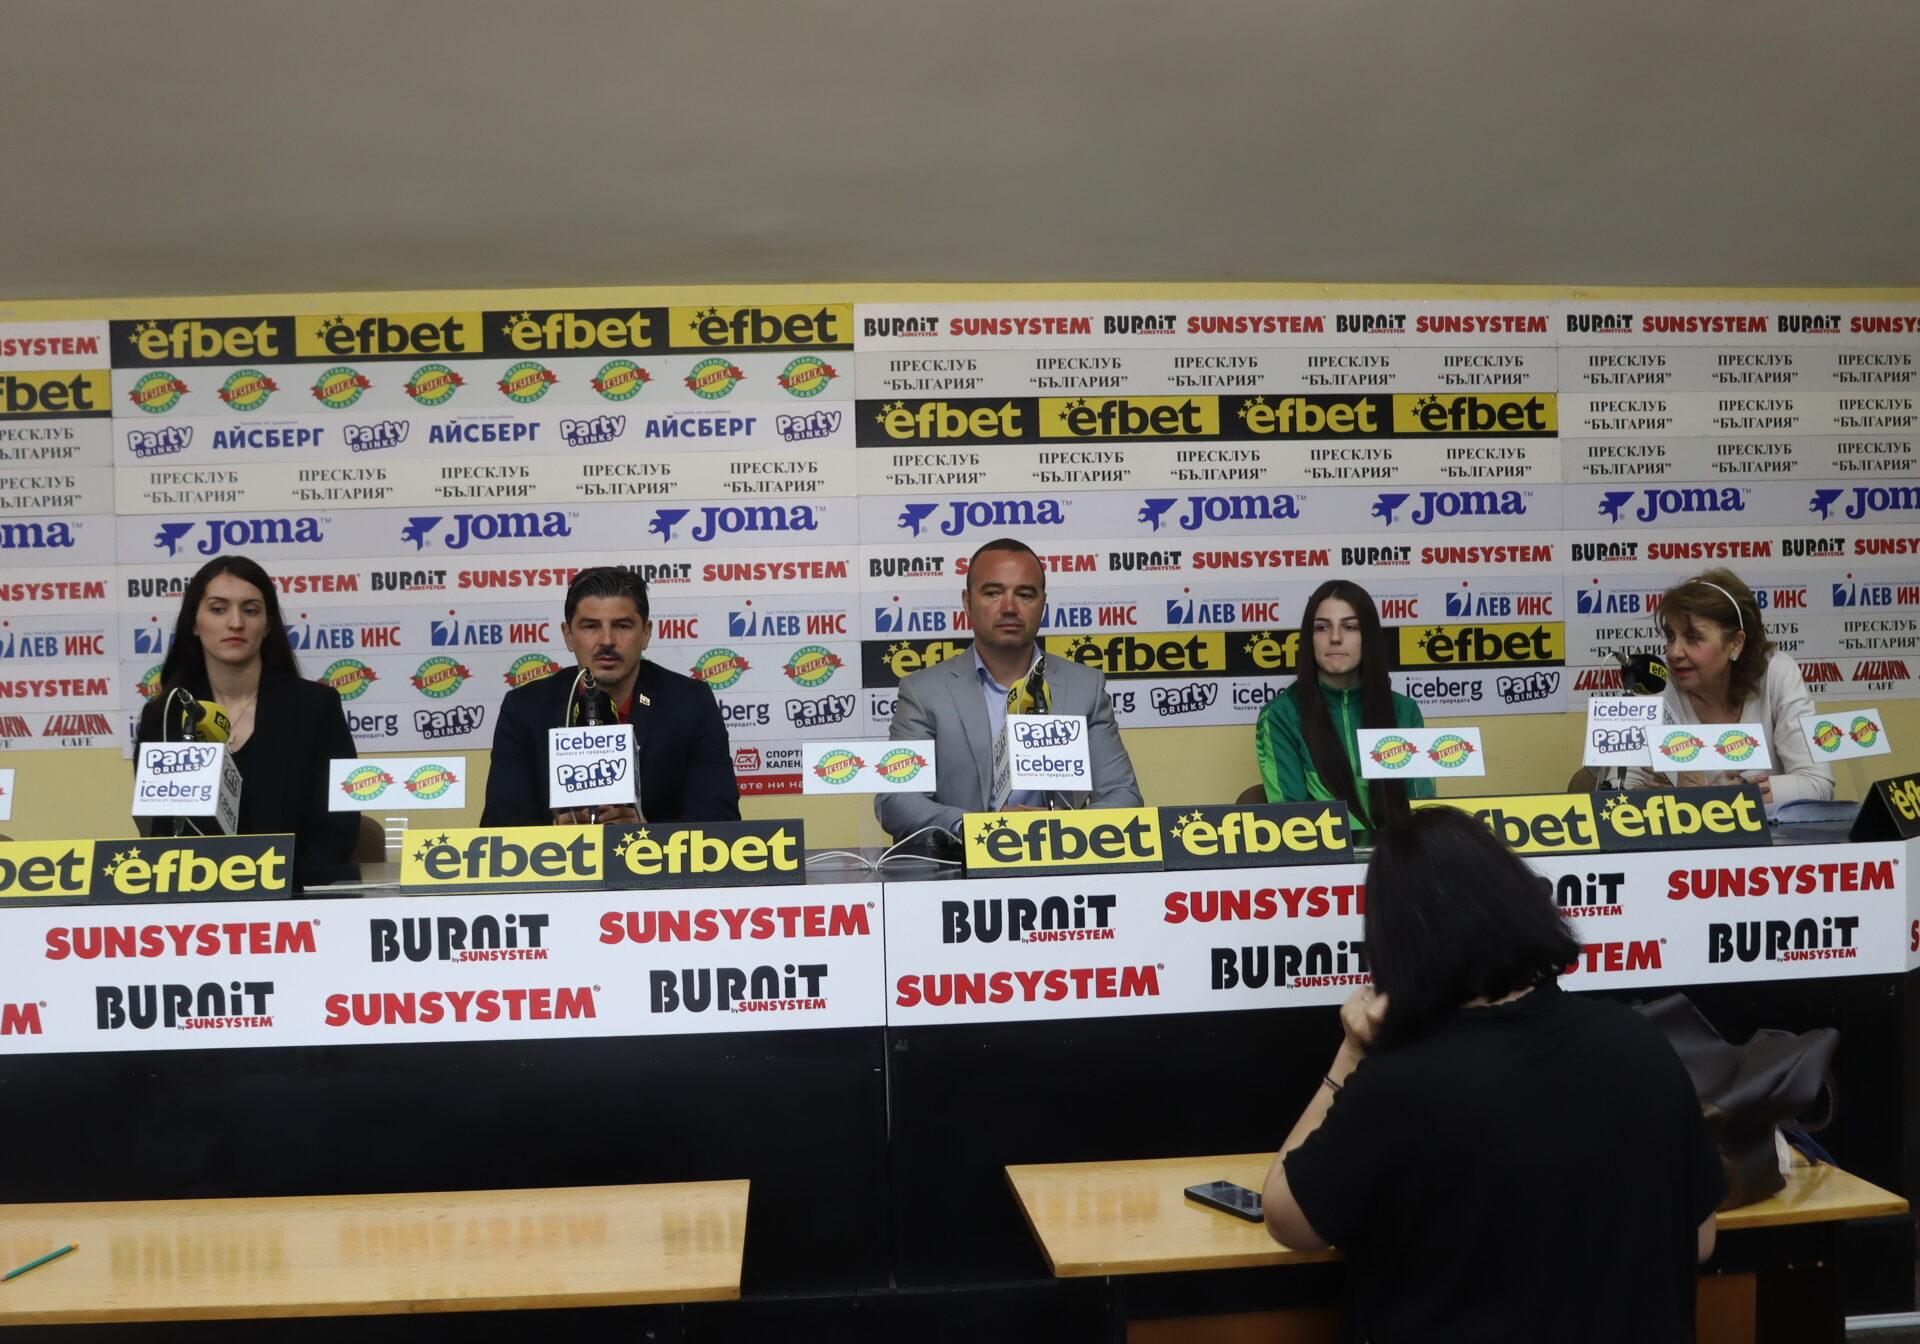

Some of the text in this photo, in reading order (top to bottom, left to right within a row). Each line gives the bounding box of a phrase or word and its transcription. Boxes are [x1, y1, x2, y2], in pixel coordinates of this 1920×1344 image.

[510, 312, 652, 350] efbet
[699, 308, 837, 344] efbet
[950, 318, 1090, 336] SUNSYSTEM
[1187, 316, 1324, 333] SUNSYSTEM
[1416, 316, 1547, 333] SUNSYSTEM
[1642, 316, 1767, 333] SUNSYSTEM
[139, 319, 279, 359] efbet
[325, 316, 465, 353] efbet
[0, 337, 97, 355] SYSTEM
[890, 359, 976, 371] ПРЕСКЛУБ
[1174, 356, 1258, 368] ПРЕСКЛУБ
[1444, 356, 1523, 367] ПРЕСКЛУБ
[1718, 355, 1792, 365] ПРЕСКЛУБ
[0, 374, 94, 411] bet
[1419, 396, 1546, 431] efbet
[1590, 401, 1666, 412] ПРЕСКЛУБ
[1839, 399, 1912, 410] ПРЕСКЛУБ
[776, 410, 841, 433] Party
[884, 401, 1022, 439] efbet
[1067, 398, 1201, 434] efbet
[1246, 397, 1377, 434] efbet
[344, 422, 409, 444] Party
[429, 422, 540, 443] АЙСБЕРГ
[560, 416, 626, 439] Party
[646, 416, 756, 437] АЙСБЕРГ
[784, 428, 829, 442] DRINKS
[127, 427, 193, 449] Party
[212, 428, 324, 449] АЙСБЕРГ
[352, 437, 397, 452] DRINKS
[568, 433, 614, 447] DRINKS
[136, 442, 181, 458] DRINKS
[1176, 450, 1260, 462] ПРЕСКЛУБ
[1447, 448, 1525, 459] ПРЕСКЛУБ
[1717, 444, 1792, 455] ПРЕСКЛУБ
[1838, 443, 1911, 454] ПРЕСКЛУБ
[893, 454, 979, 466] ПРЕСКЛУБ
[299, 469, 386, 481] ПРЕСКЛУБ
[583, 464, 671, 476] ПРЕСКЛУБ
[1421, 546, 1552, 564] SUNSYSTEM
[1648, 540, 1771, 559] SUNSYSTEM
[1192, 551, 1328, 568] SUNSYSTEM
[703, 563, 847, 581] SUNSYSTEM
[0, 582, 105, 600] NSYSTEM
[1774, 590, 1807, 608] ИНС
[1860, 587, 1892, 605] ЛЕВ
[1199, 603, 1279, 623] ЛЕВ ИНС
[1382, 600, 1418, 618] ИНС
[1476, 596, 1552, 615] ЛЕВ ИНС
[1606, 595, 1640, 613] ЛЕВ
[908, 609, 947, 631] ЛЕВ
[1055, 601, 1137, 627] ЛЕВ ИНС
[464, 618, 549, 645] ЛЕВ ИНС
[659, 619, 698, 638] ИНС
[762, 614, 847, 636] ЛЕВ ИНС
[1844, 621, 1916, 632] ПРЕСКЛУБ
[19, 636, 104, 657] ЛЕВ ИНС
[316, 626, 401, 648] ЛЕВ ИНС
[1427, 626, 1552, 662] efbet
[1074, 636, 1208, 672] efbet
[1852, 660, 1910, 681] LAZZARIN
[1407, 677, 1483, 700] iceberg
[1497, 671, 1560, 694] Party
[1151, 683, 1218, 708] Party
[1505, 691, 1548, 704] DRINKS
[786, 695, 855, 717] Party
[1160, 702, 1205, 716] DRINKS
[1593, 701, 1657, 720] iceberg
[42, 714, 113, 736] LAZZARIN
[415, 705, 484, 728] Party
[795, 711, 841, 728] DRINKS
[424, 722, 471, 739] DRINKS
[1014, 719, 1080, 741] Party
[556, 732, 627, 751] iceberg
[1023, 737, 1069, 748] DRINKS
[1598, 742, 1642, 754] DRINKS
[146, 746, 216, 766] Party
[766, 760, 803, 769] КАЛЕН
[1016, 754, 1085, 777] iceberg
[152, 763, 201, 775] DRINKS
[557, 758, 627, 785] Party
[140, 780, 213, 802] iceberg
[566, 777, 614, 793] DRINKS
[1611, 792, 1762, 838] efbet
[986, 815, 1154, 862] efbet
[1182, 809, 1347, 857] efbet
[425, 831, 597, 882] efbet
[625, 827, 797, 874] efbet
[114, 847, 288, 894] efbet
[1667, 861, 1895, 900] SUNSYSTEM
[600, 904, 870, 944] SUNSYSTEM
[45, 921, 316, 960] SUNSYSTEM
[1029, 929, 1115, 942] SUNSYSTEM
[459, 949, 548, 961] SUNSYSTEM
[1784, 948, 1857, 961] SUNSYSTEM
[896, 966, 1159, 1007] SUNSYSTEM
[325, 986, 596, 1027] SUNSYSTEM
[186, 1016, 273, 1029] SUNSYSTEM
